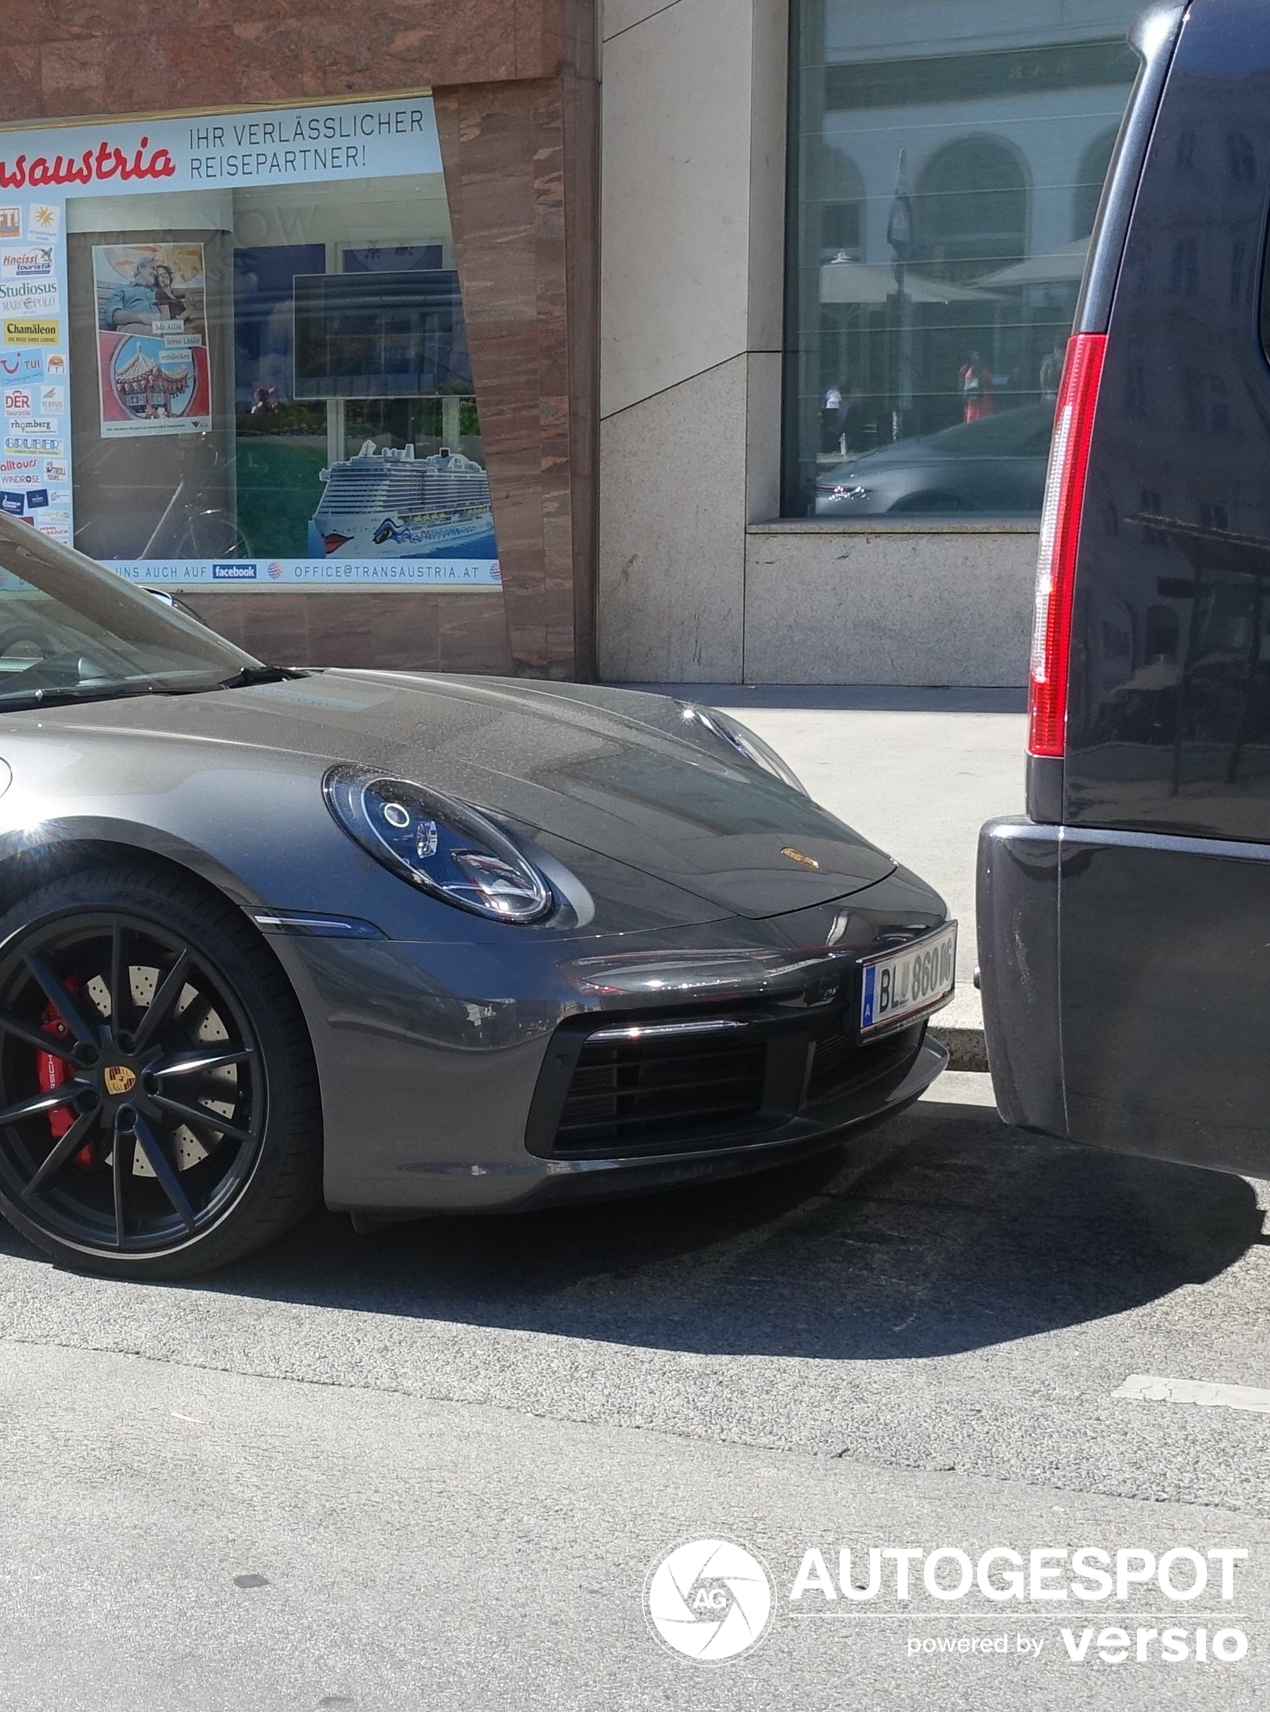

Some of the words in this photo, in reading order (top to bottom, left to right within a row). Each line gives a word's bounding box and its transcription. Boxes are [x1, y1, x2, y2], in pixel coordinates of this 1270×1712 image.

[189, 126, 225, 150] IHR
[233, 110, 424, 146] VERLÄSSLICHER
[190, 145, 367, 179] REISEPARTNER!
[3, 254, 38, 266] Kneissl
[7, 322, 56, 334] Chamäleon
[24, 360, 40, 369] TUI
[5, 395, 30, 408] DER
[11, 419, 51, 430] rhomberg
[5, 438, 60, 450] GRUBER
[0, 459, 37, 472] alltours
[1, 475, 40, 484] WINDROSE
[145, 566, 178, 578] AUCH
[184, 566, 207, 578] AUF
[215, 566, 254, 577] facebook
[294, 564, 479, 578] OFFICE@TRANSAUSTRIA.AT
[879, 964, 899, 1013] BL
[911, 946, 940, 1001] 860
[864, 1005, 871, 1017] A
